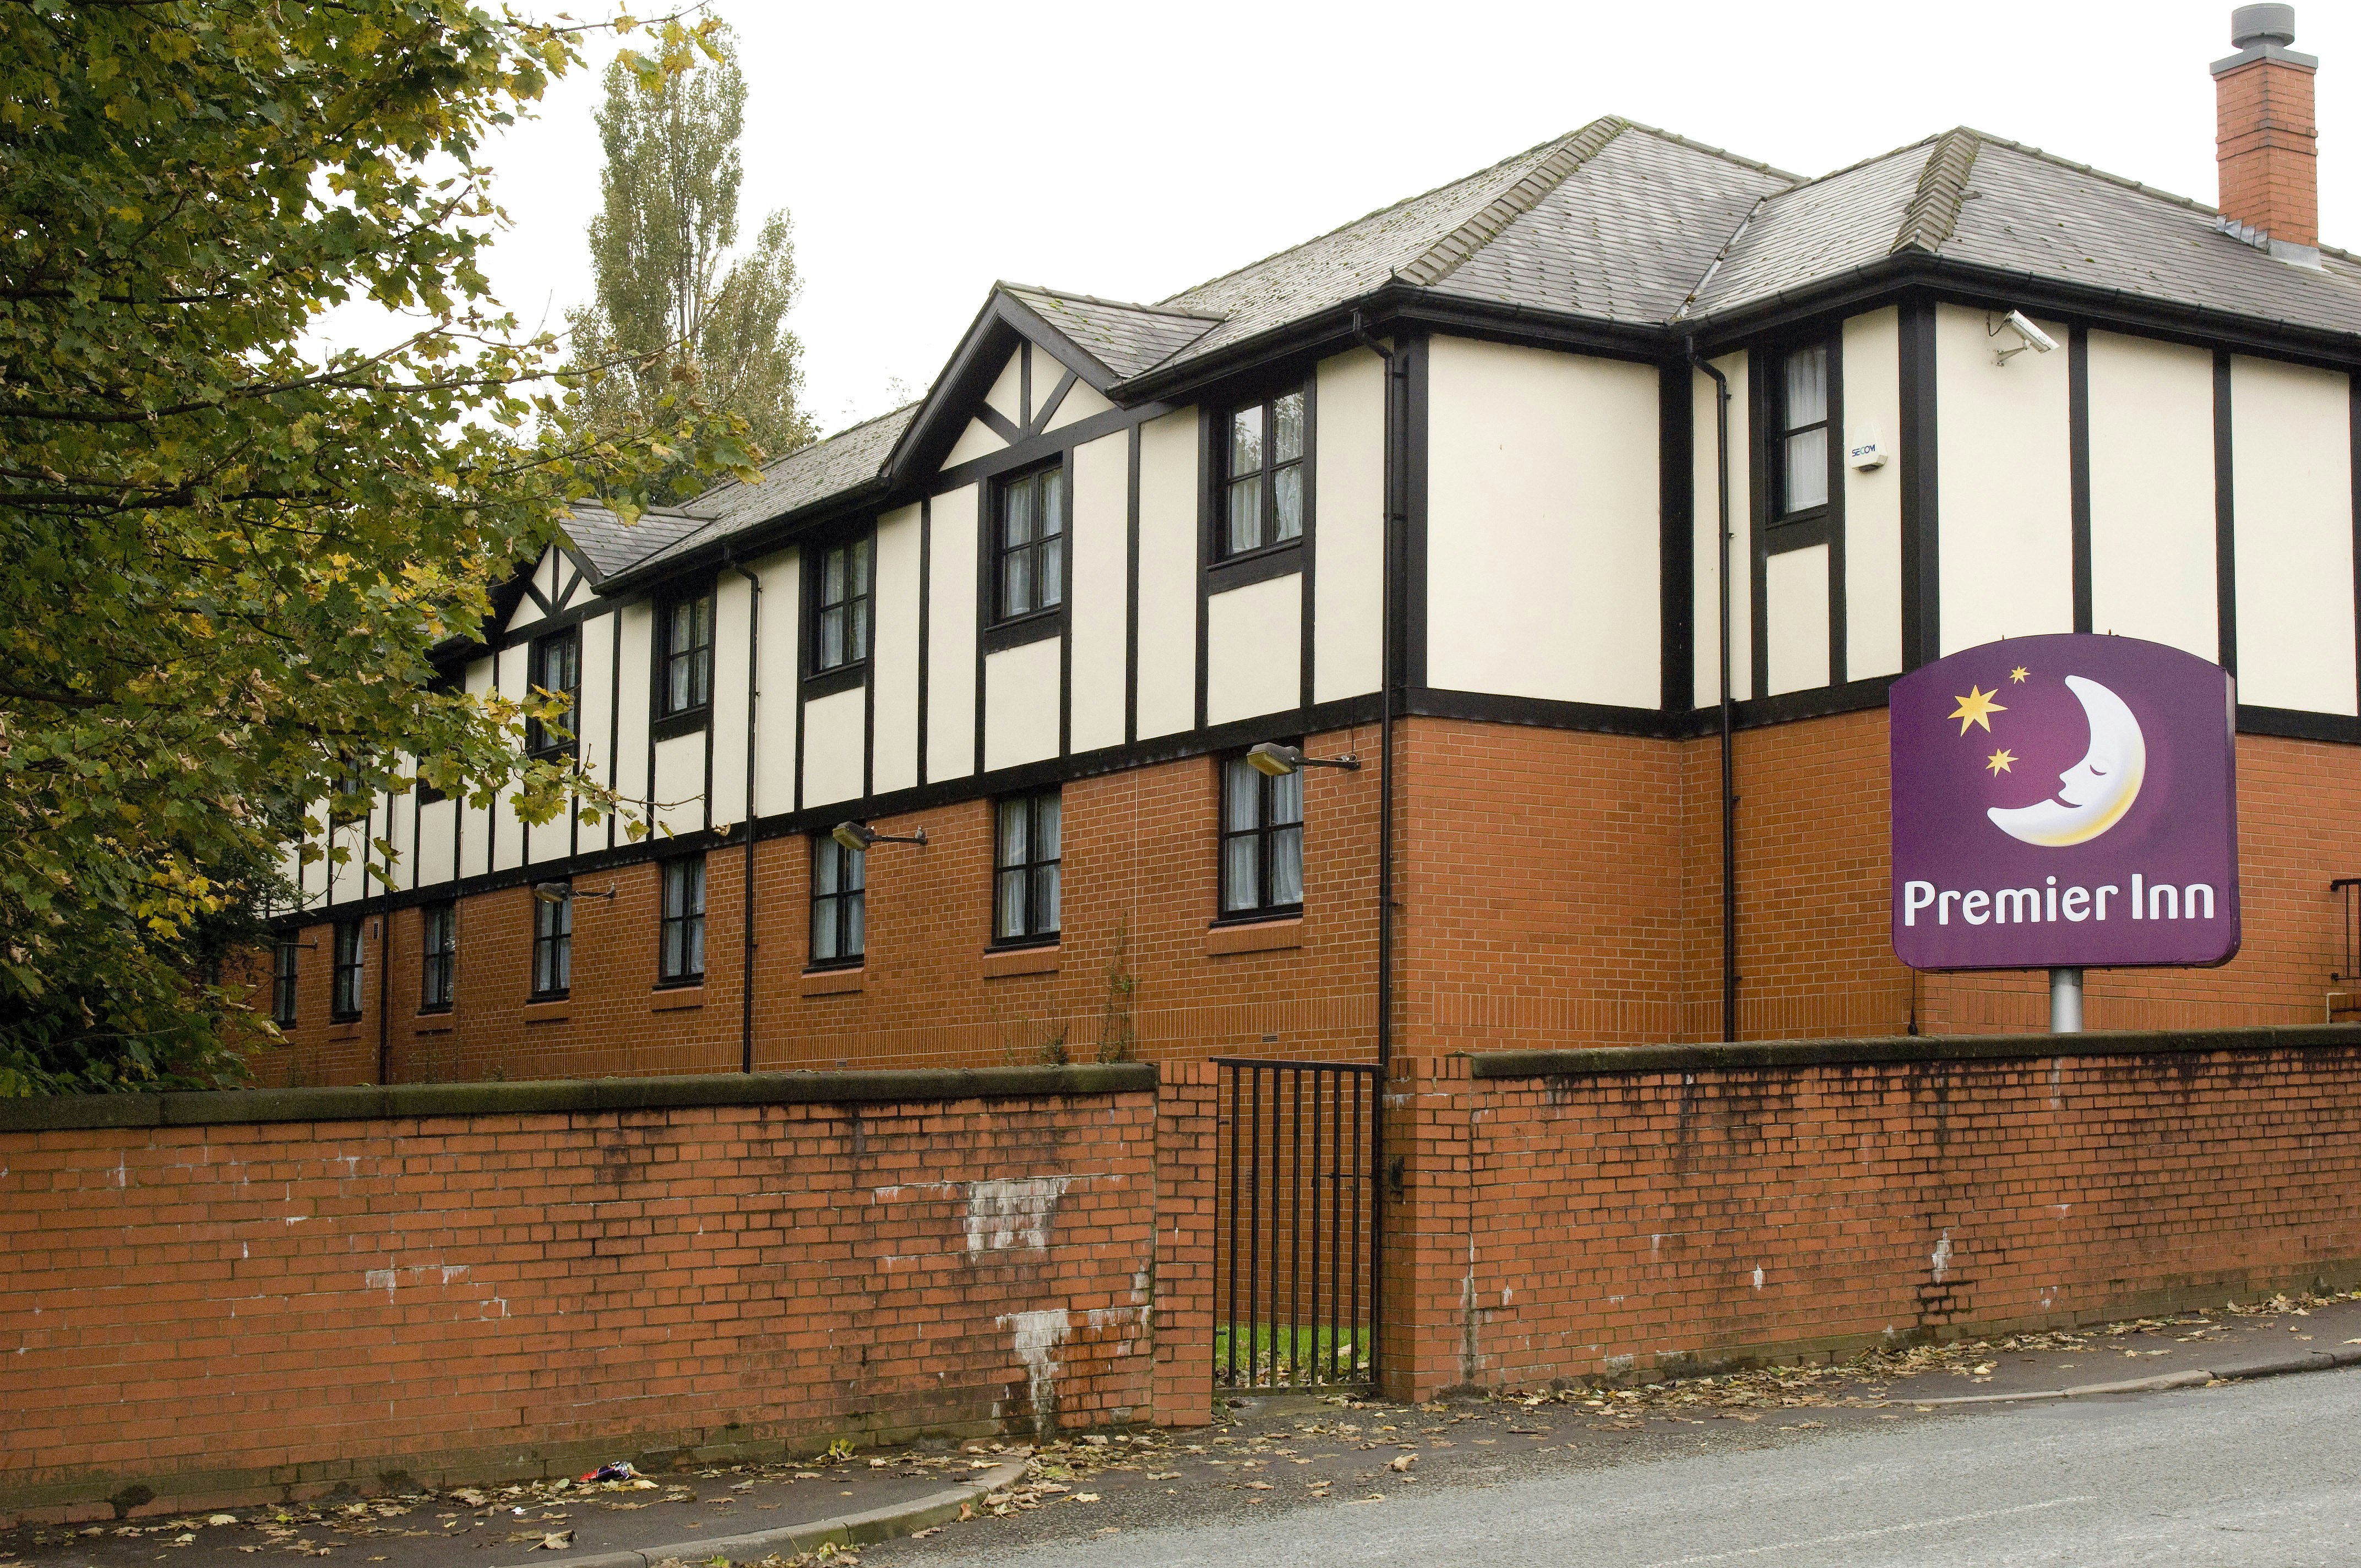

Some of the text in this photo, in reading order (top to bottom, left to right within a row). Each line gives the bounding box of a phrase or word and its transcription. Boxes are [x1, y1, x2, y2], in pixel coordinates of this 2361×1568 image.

[1852, 444, 1875, 457] SECOM
[1905, 873, 2215, 927] Premier Inn
